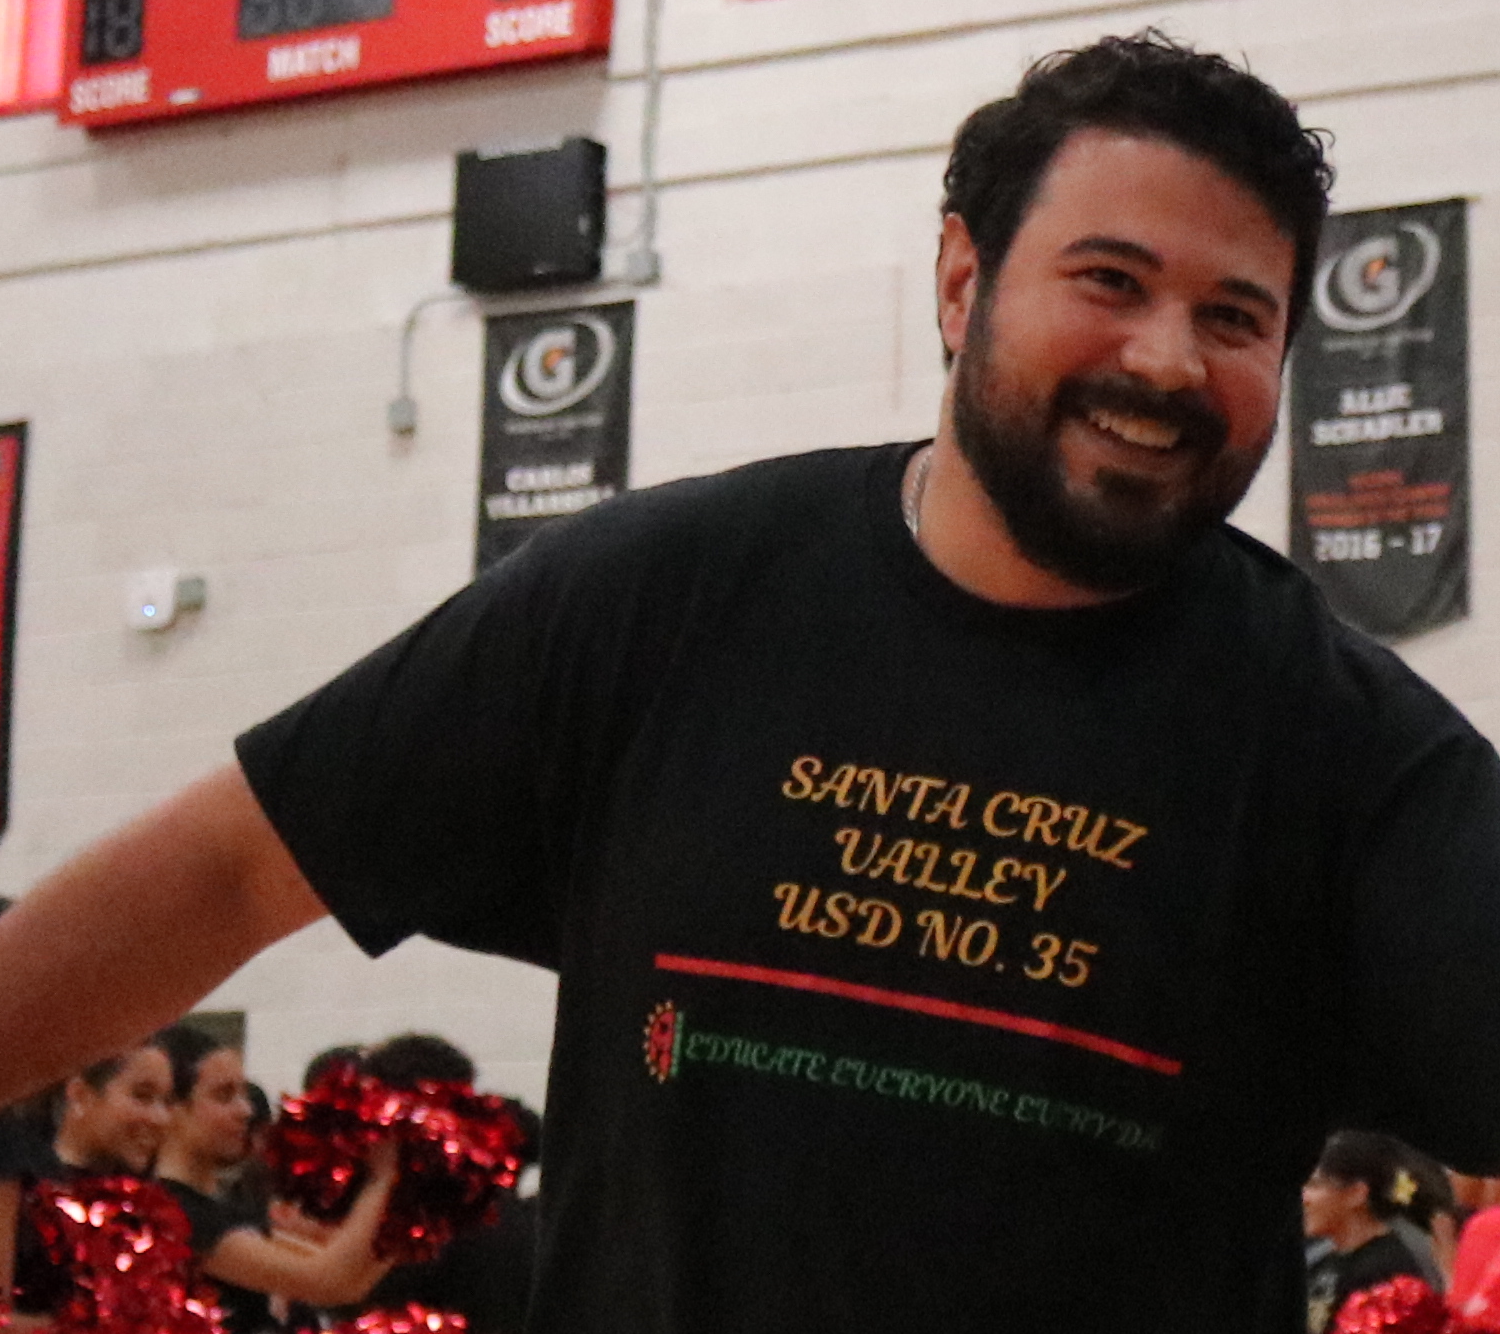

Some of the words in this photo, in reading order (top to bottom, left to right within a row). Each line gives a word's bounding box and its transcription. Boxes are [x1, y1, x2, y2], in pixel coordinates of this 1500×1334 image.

[267, 36, 361, 83] MATCH
[485, 1, 574, 48] SCORE
[71, 69, 150, 114] SCORE
[782, 754, 969, 830] SANTA
[982, 790, 1149, 870] CRUZ
[834, 827, 1067, 912] VALLEY
[773, 882, 902, 948] USD
[916, 908, 1005, 972] NO.
[1024, 933, 1098, 988] 35
[685, 1032, 828, 1082] EDUCATE
[831, 1055, 1009, 1118] EVERYONE
